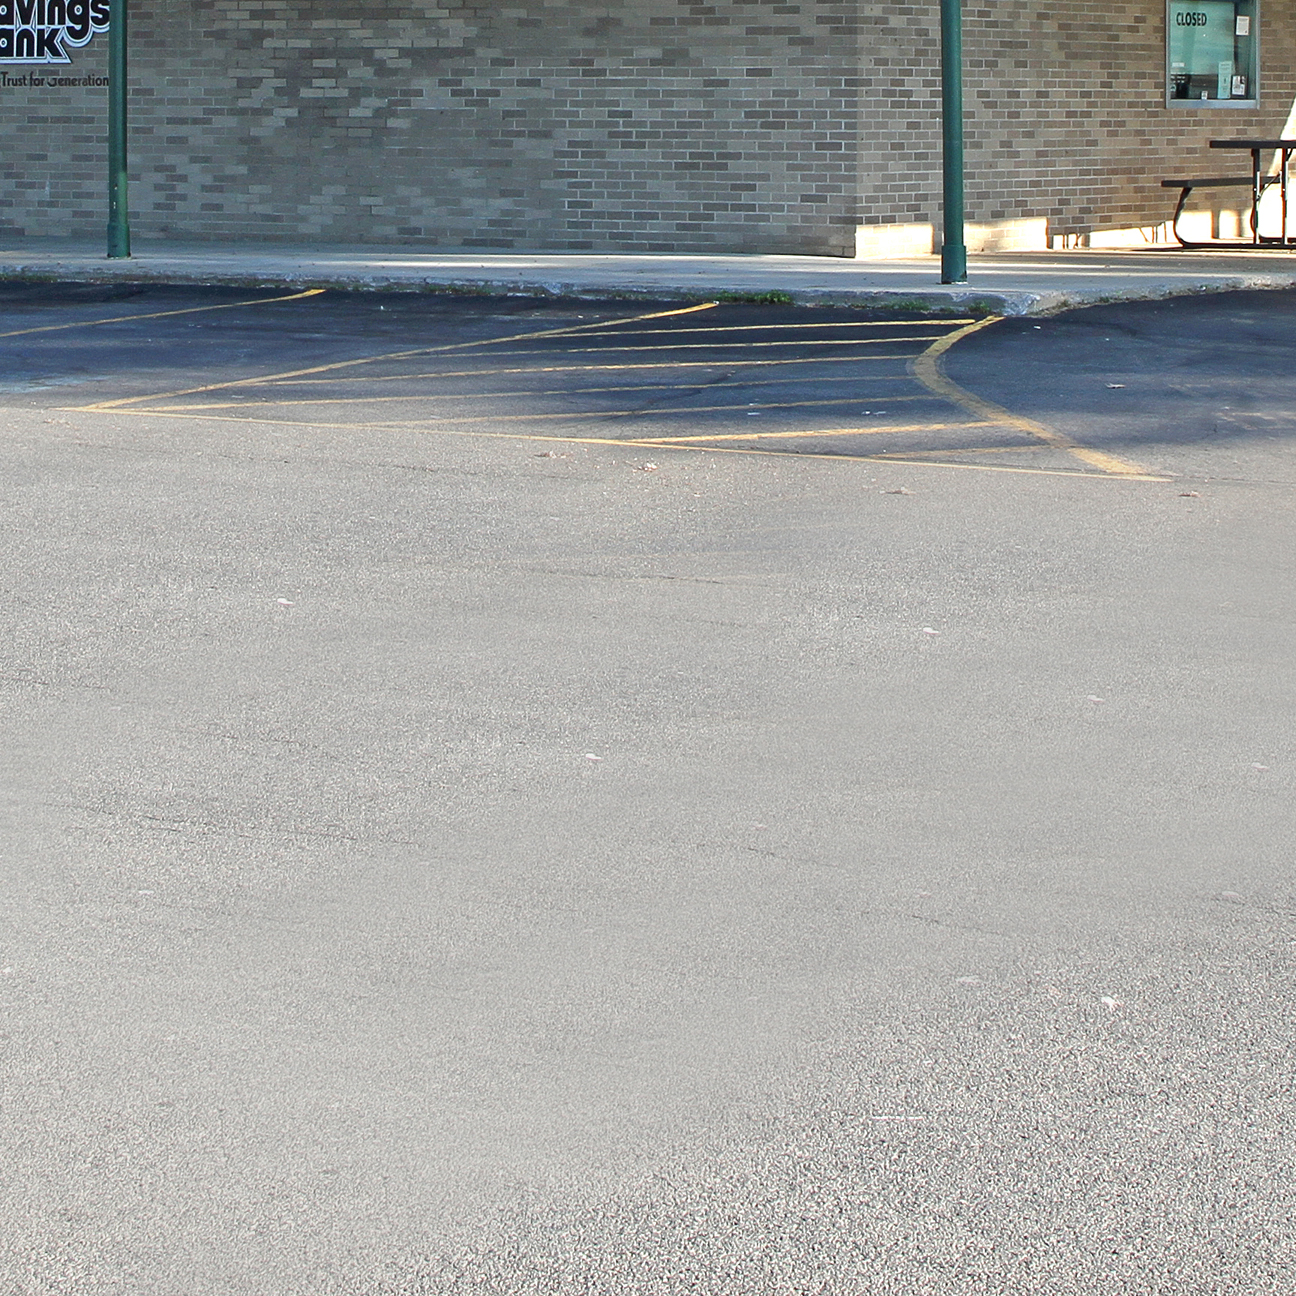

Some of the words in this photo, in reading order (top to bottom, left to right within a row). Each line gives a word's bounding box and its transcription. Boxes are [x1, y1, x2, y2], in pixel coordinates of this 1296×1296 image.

[1176, 12, 1208, 26] CLOSED
[1, 71, 28, 87] Trust
[29, 70, 49, 89] for
